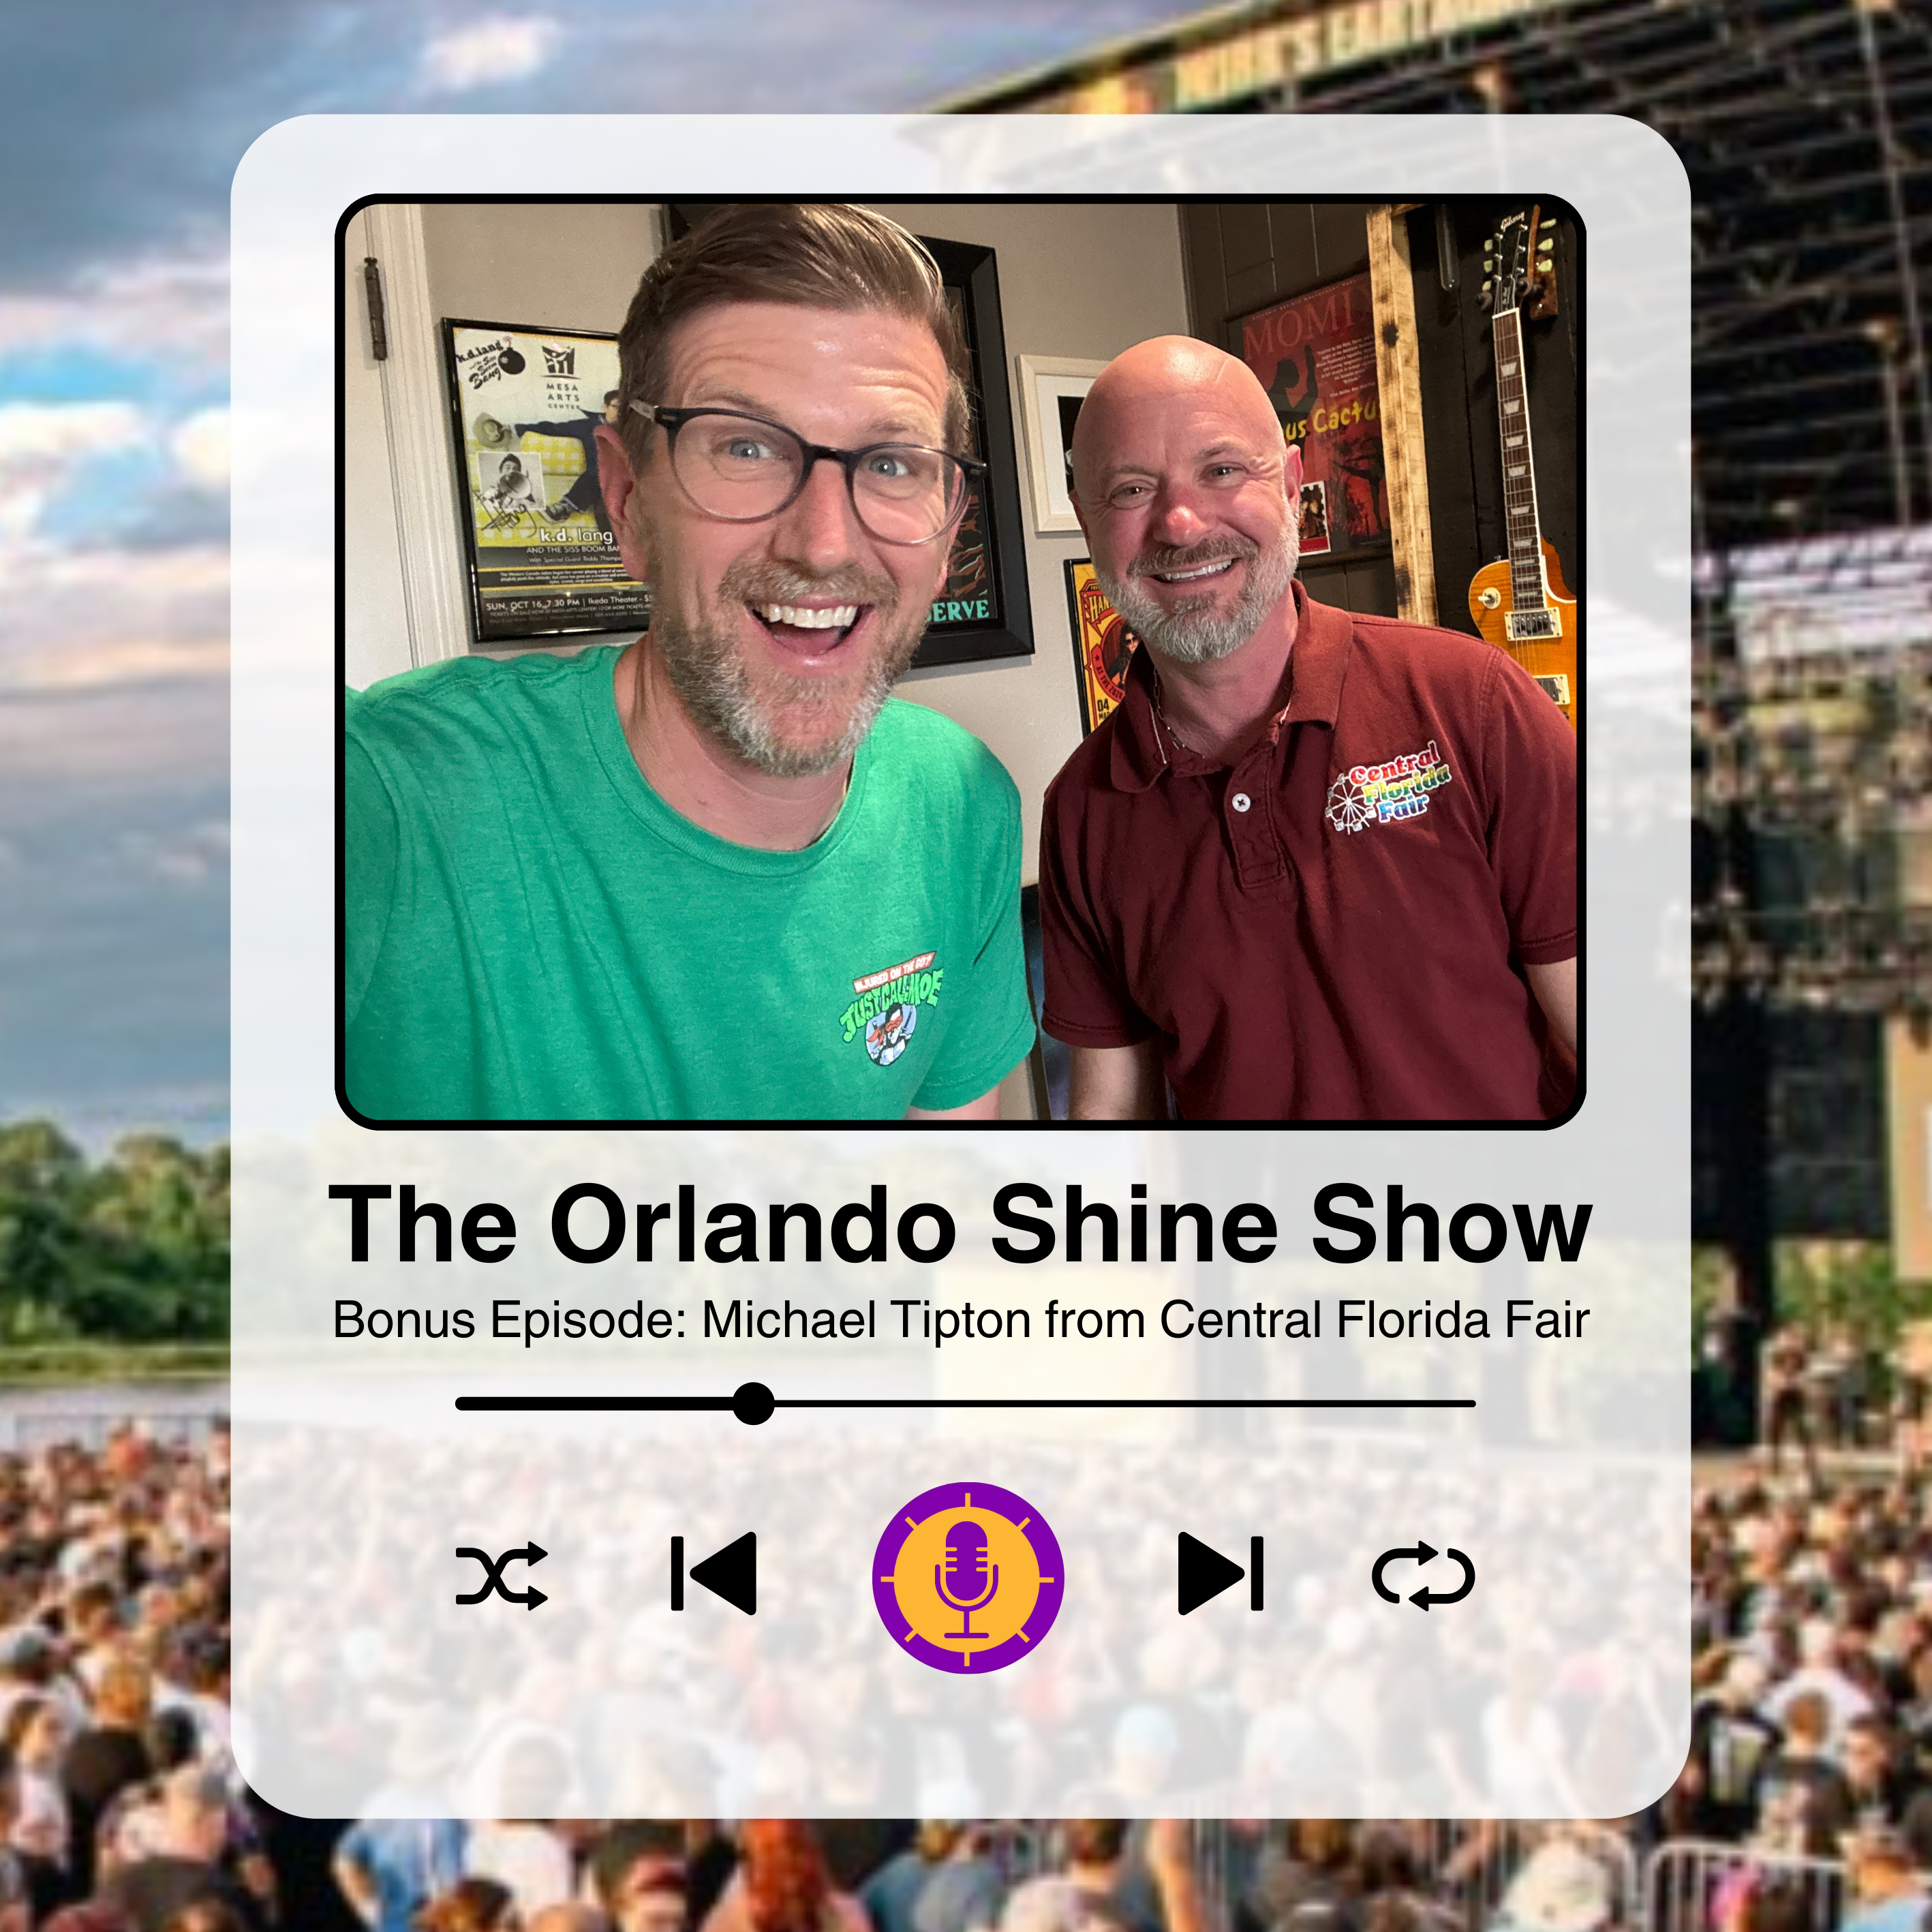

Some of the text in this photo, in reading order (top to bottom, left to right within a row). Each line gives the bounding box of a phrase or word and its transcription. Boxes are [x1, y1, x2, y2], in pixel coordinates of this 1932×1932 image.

[1244, 289, 1356, 361] MOMI
[547, 383, 578, 391] MESA
[1285, 401, 1377, 441] us Cactu
[540, 527, 613, 545] k.d. lang
[510, 600, 529, 609] OCT
[1089, 595, 1114, 624] HAN
[1096, 666, 1103, 674] AT
[1101, 675, 1110, 689] THE
[1097, 699, 1109, 712] 04
[1349, 740, 1440, 785] Central
[1362, 764, 1452, 804] Florida
[1377, 795, 1429, 823] Fair
[854, 955, 932, 991] INJURED ON THE GO?
